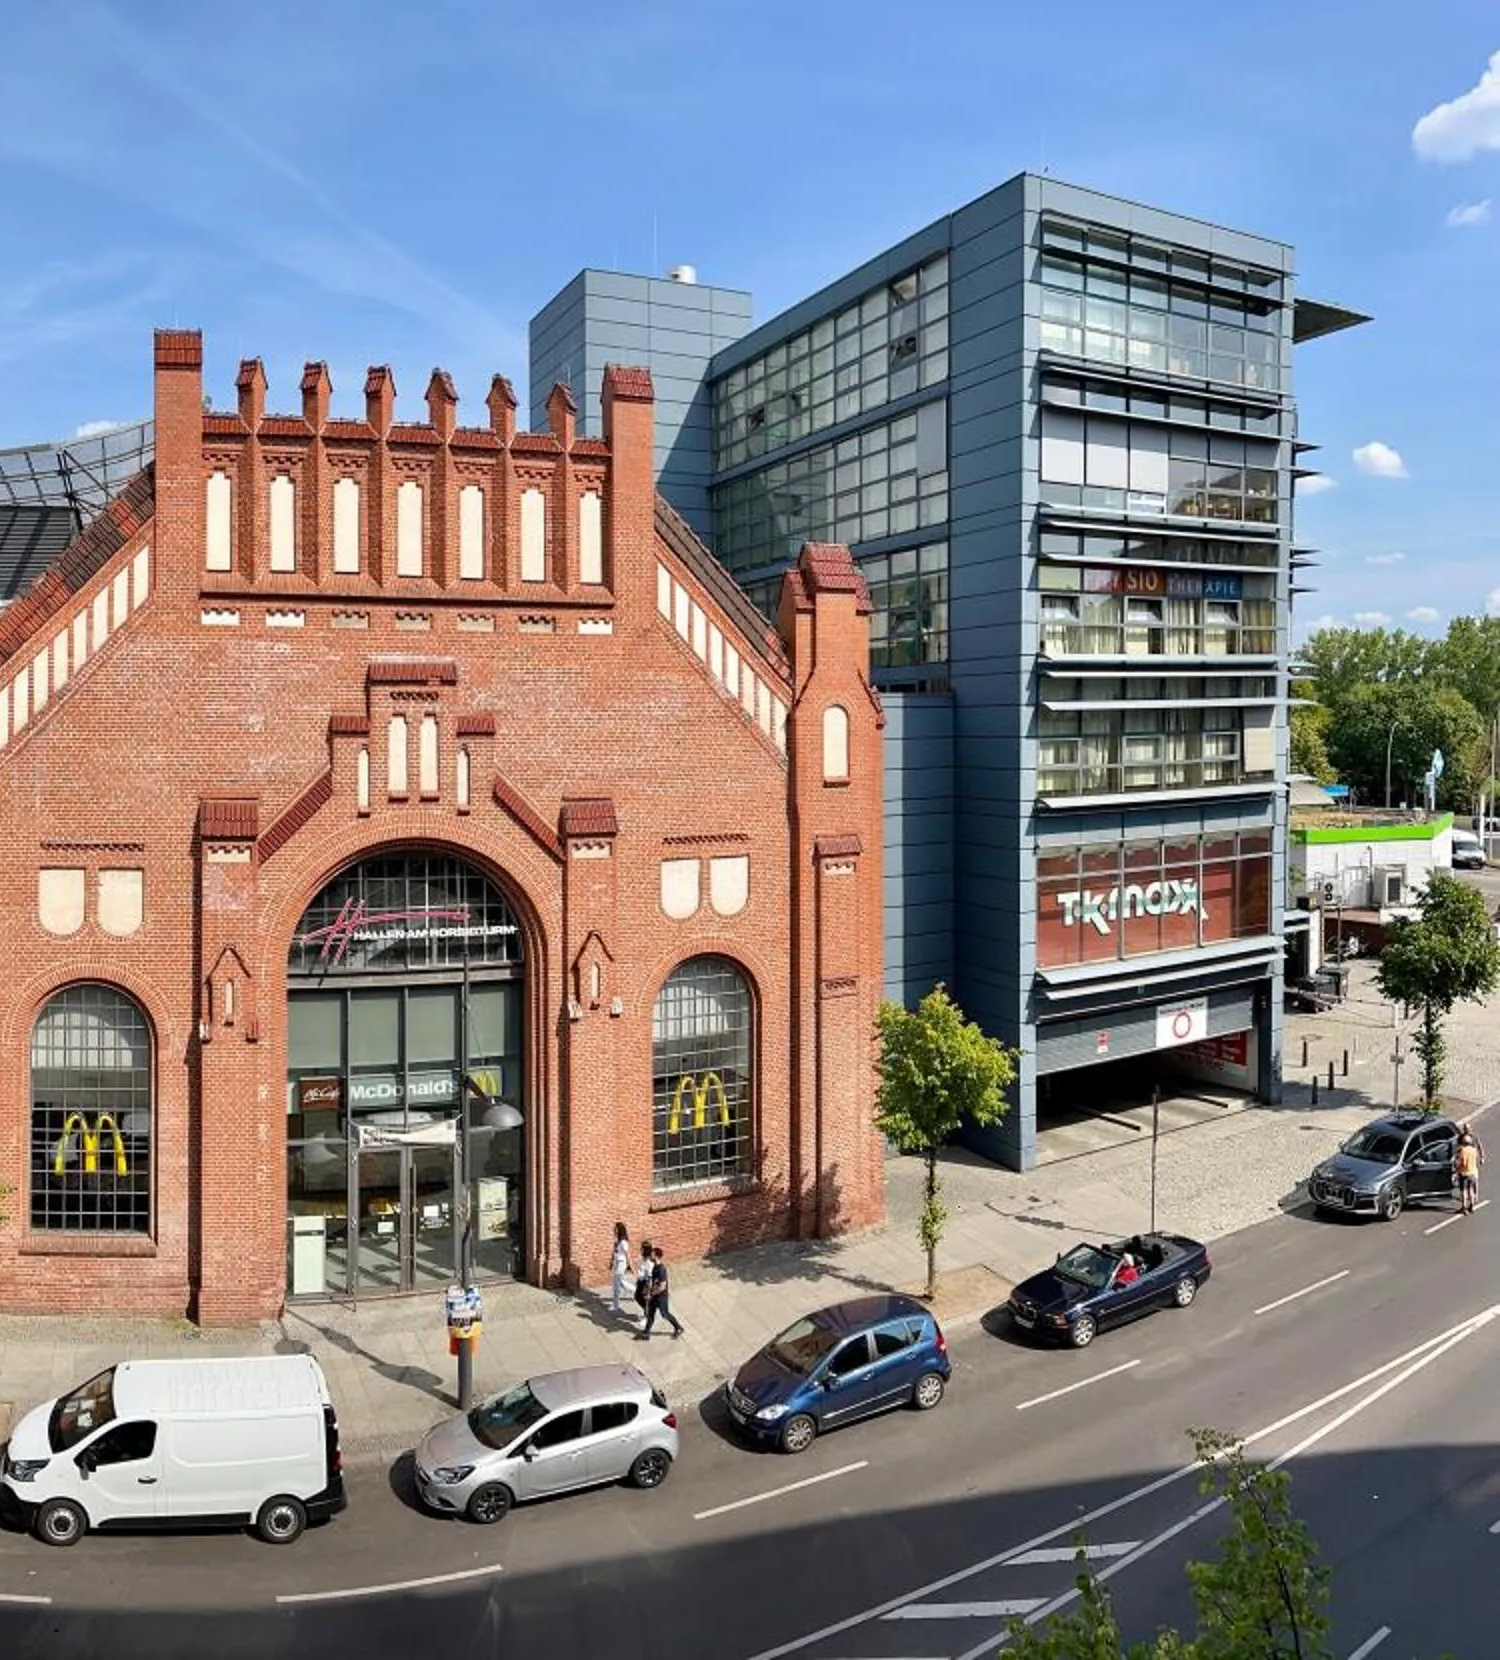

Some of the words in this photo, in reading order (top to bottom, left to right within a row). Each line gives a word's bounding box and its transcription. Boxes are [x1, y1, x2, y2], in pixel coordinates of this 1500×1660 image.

[353, 929, 404, 941] HALLEN
[406, 927, 426, 939] AM
[350, 1079, 458, 1100] McDonald's
